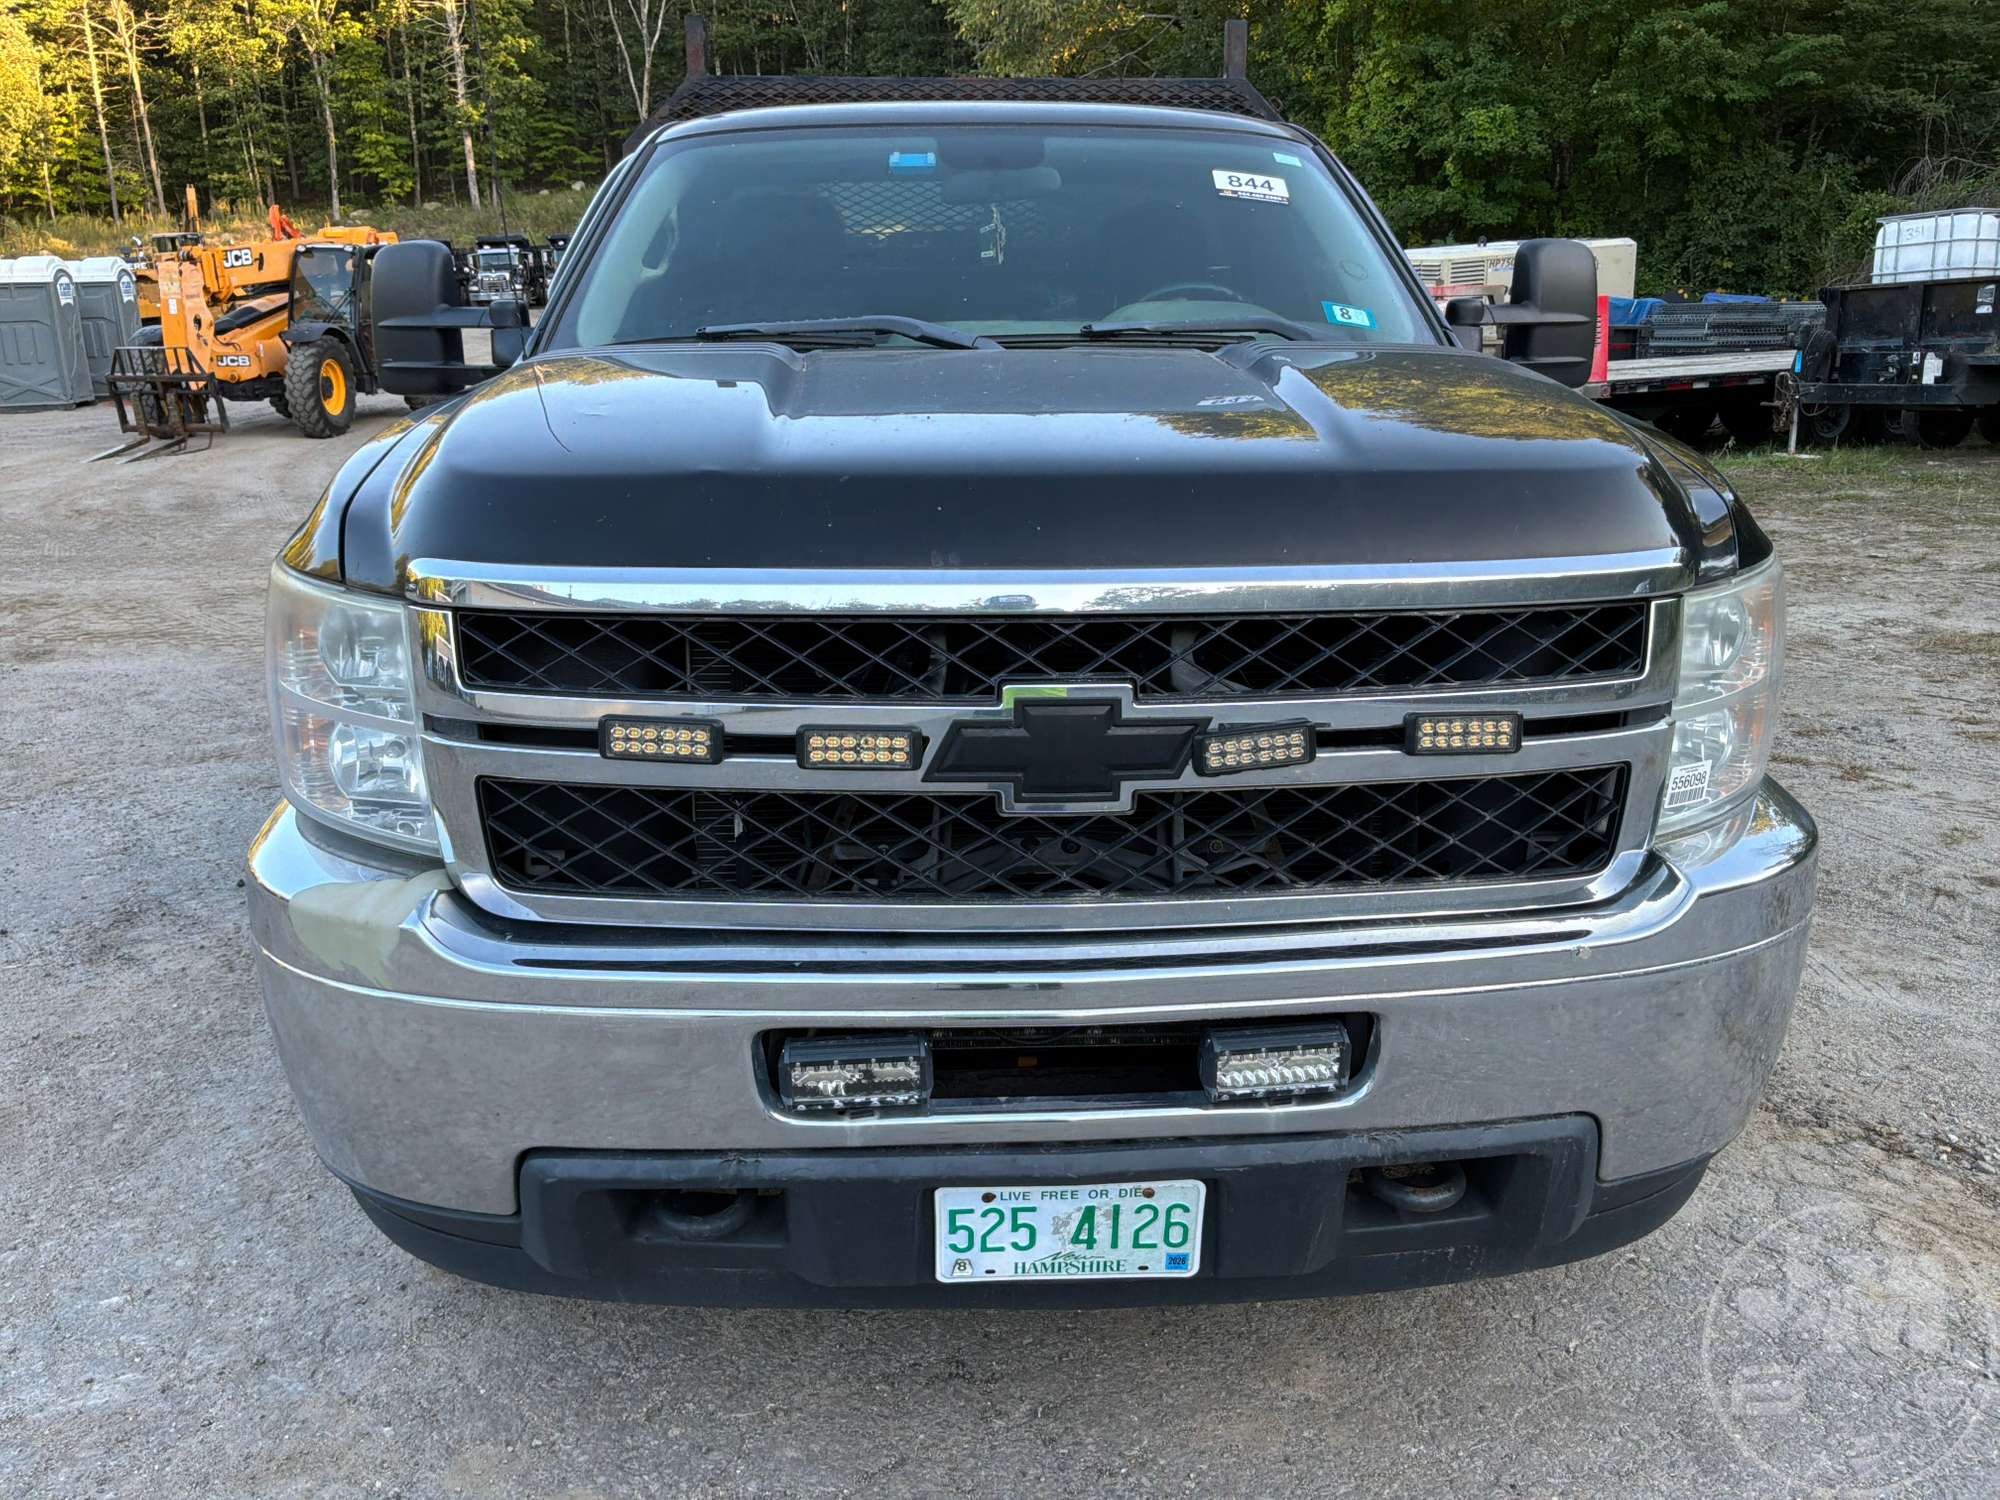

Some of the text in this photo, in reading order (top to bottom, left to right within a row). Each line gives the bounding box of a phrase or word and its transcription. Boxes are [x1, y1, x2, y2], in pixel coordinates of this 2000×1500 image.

[1228, 175, 1274, 191] 844
[223, 249, 251, 267] JCB
[1339, 307, 1351, 319] 8
[218, 356, 250, 366] JCB
[1671, 771, 1707, 790] 556098
[1000, 1187, 1143, 1201] LIVE FREE OR DIE
[948, 1203, 1191, 1253] 525 4126
[957, 1261, 967, 1272] 8
[1014, 1260, 1127, 1275] HAMPSHIRE
[1168, 1257, 1186, 1266] 2026
